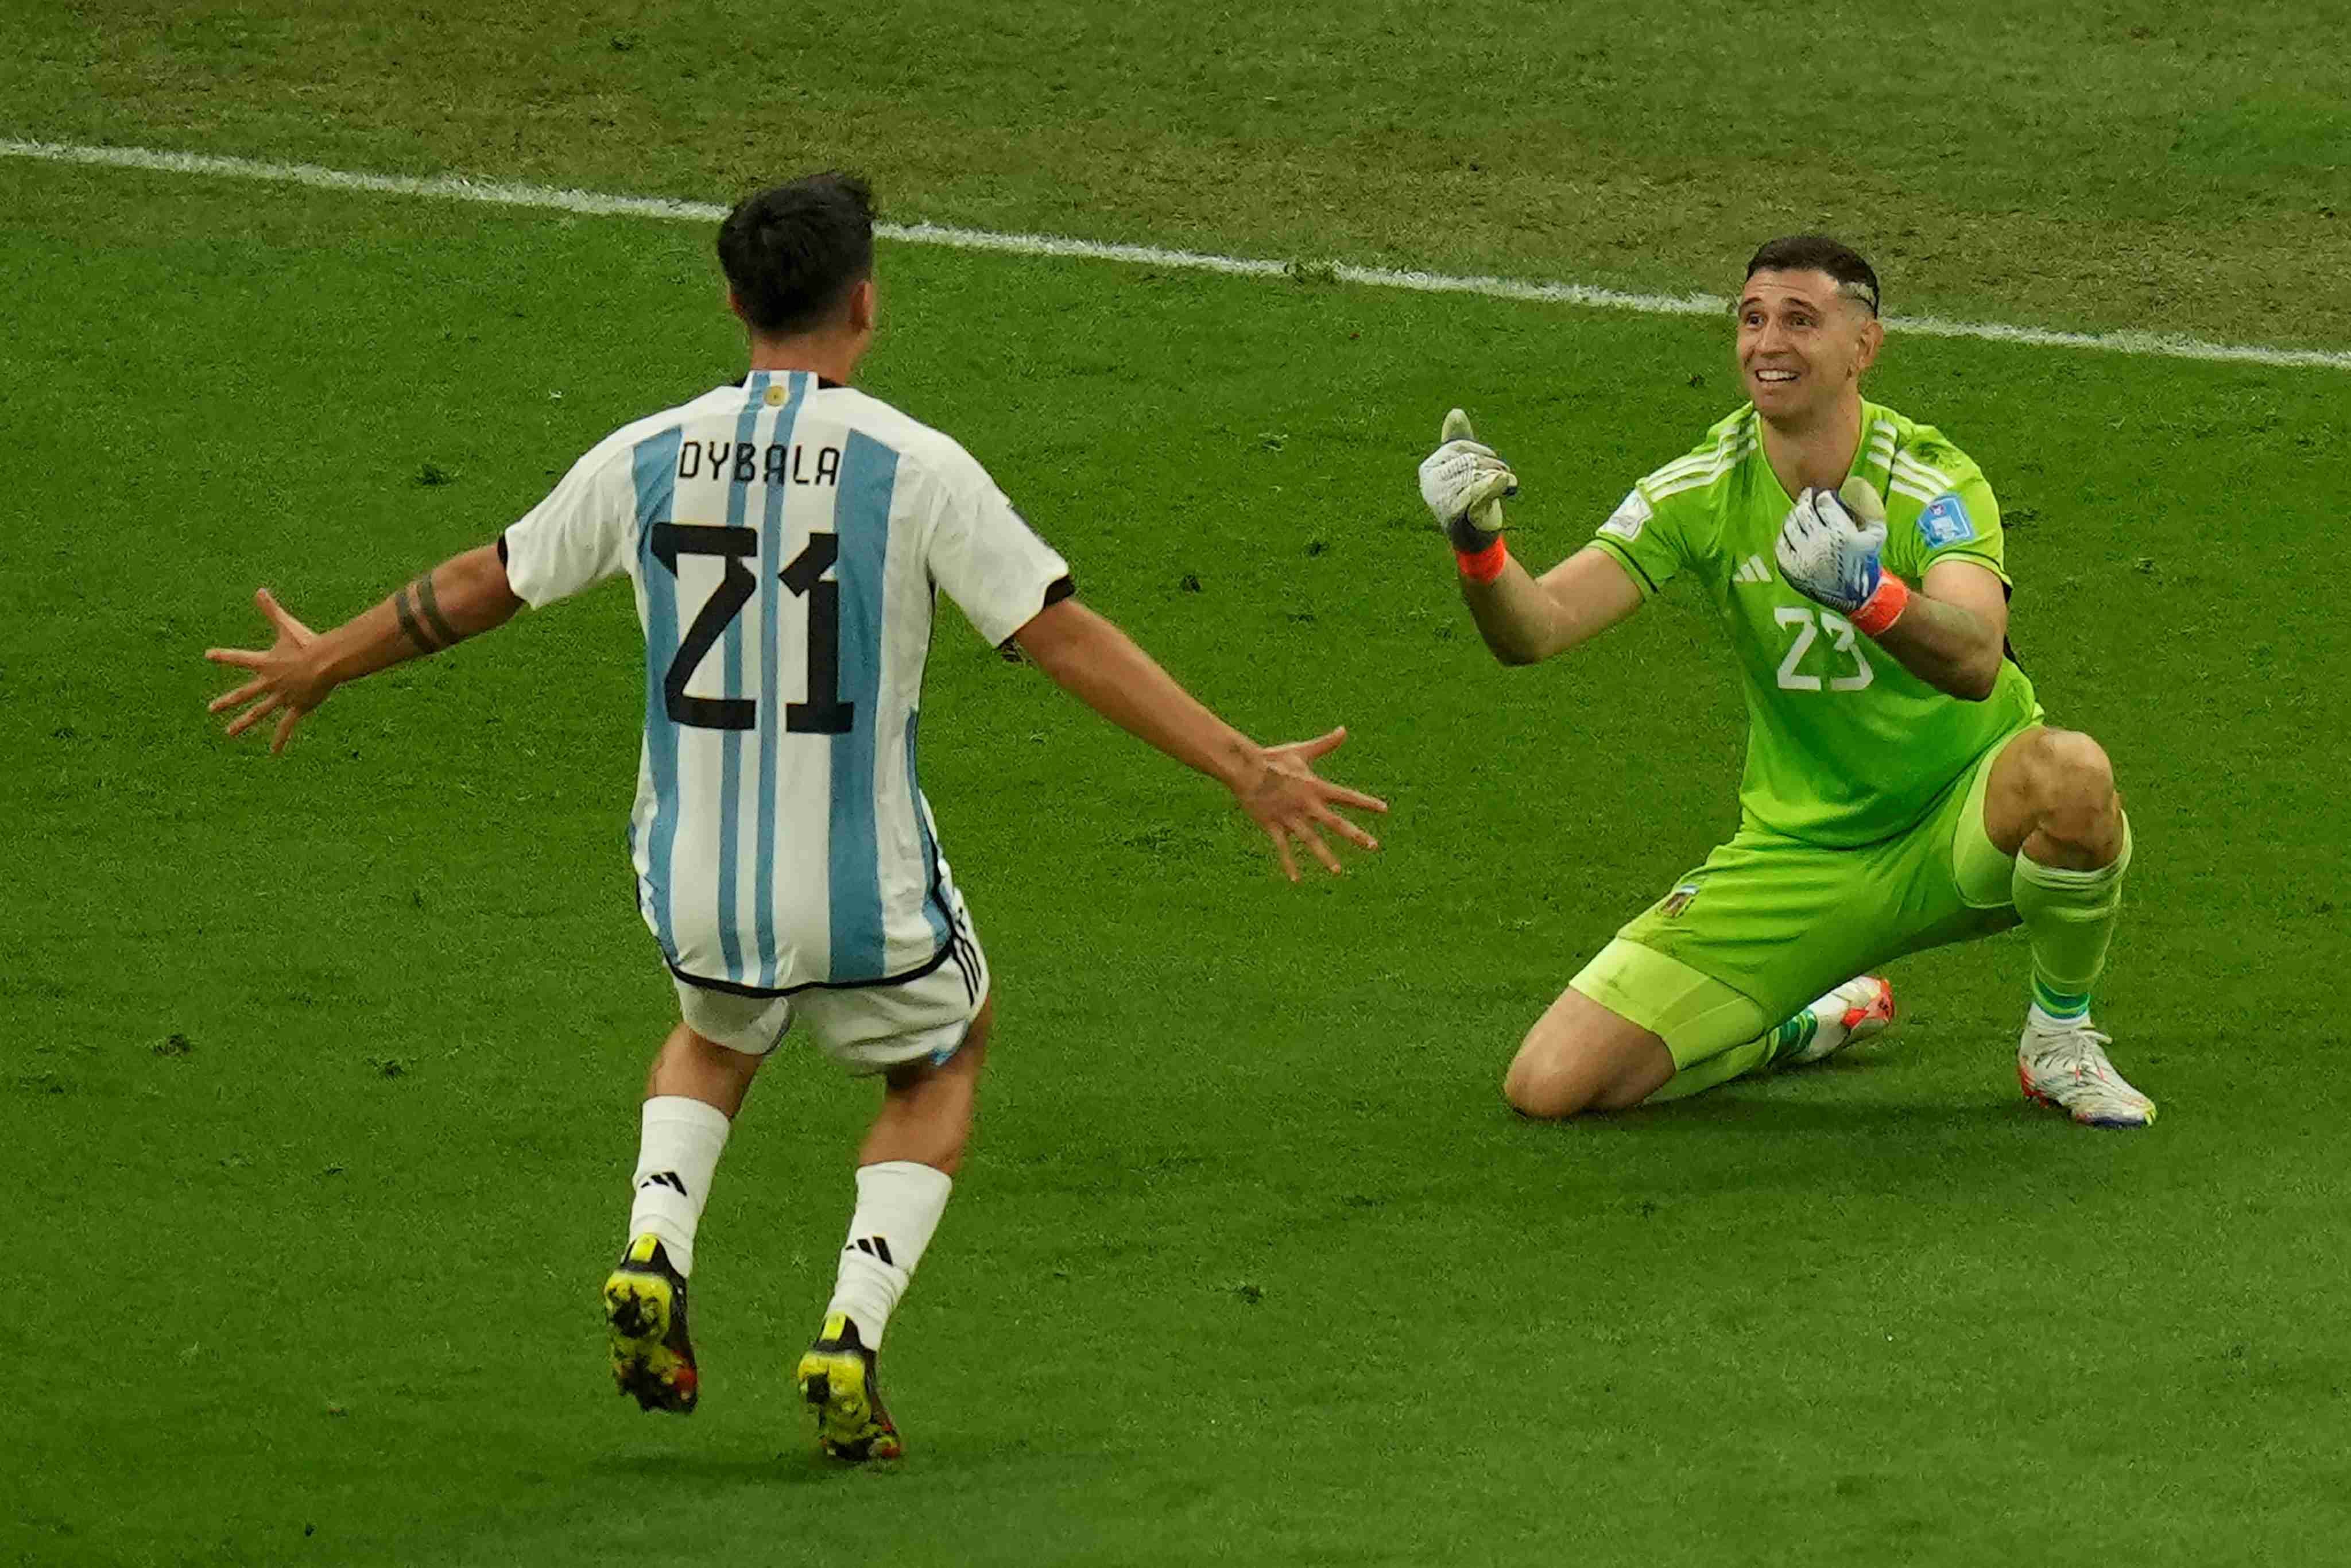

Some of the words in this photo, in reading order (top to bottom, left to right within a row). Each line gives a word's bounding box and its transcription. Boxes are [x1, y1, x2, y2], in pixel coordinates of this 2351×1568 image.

[679, 442, 841, 486] DYBALA
[650, 522, 854, 735] 21
[1774, 607, 1874, 691] 23
